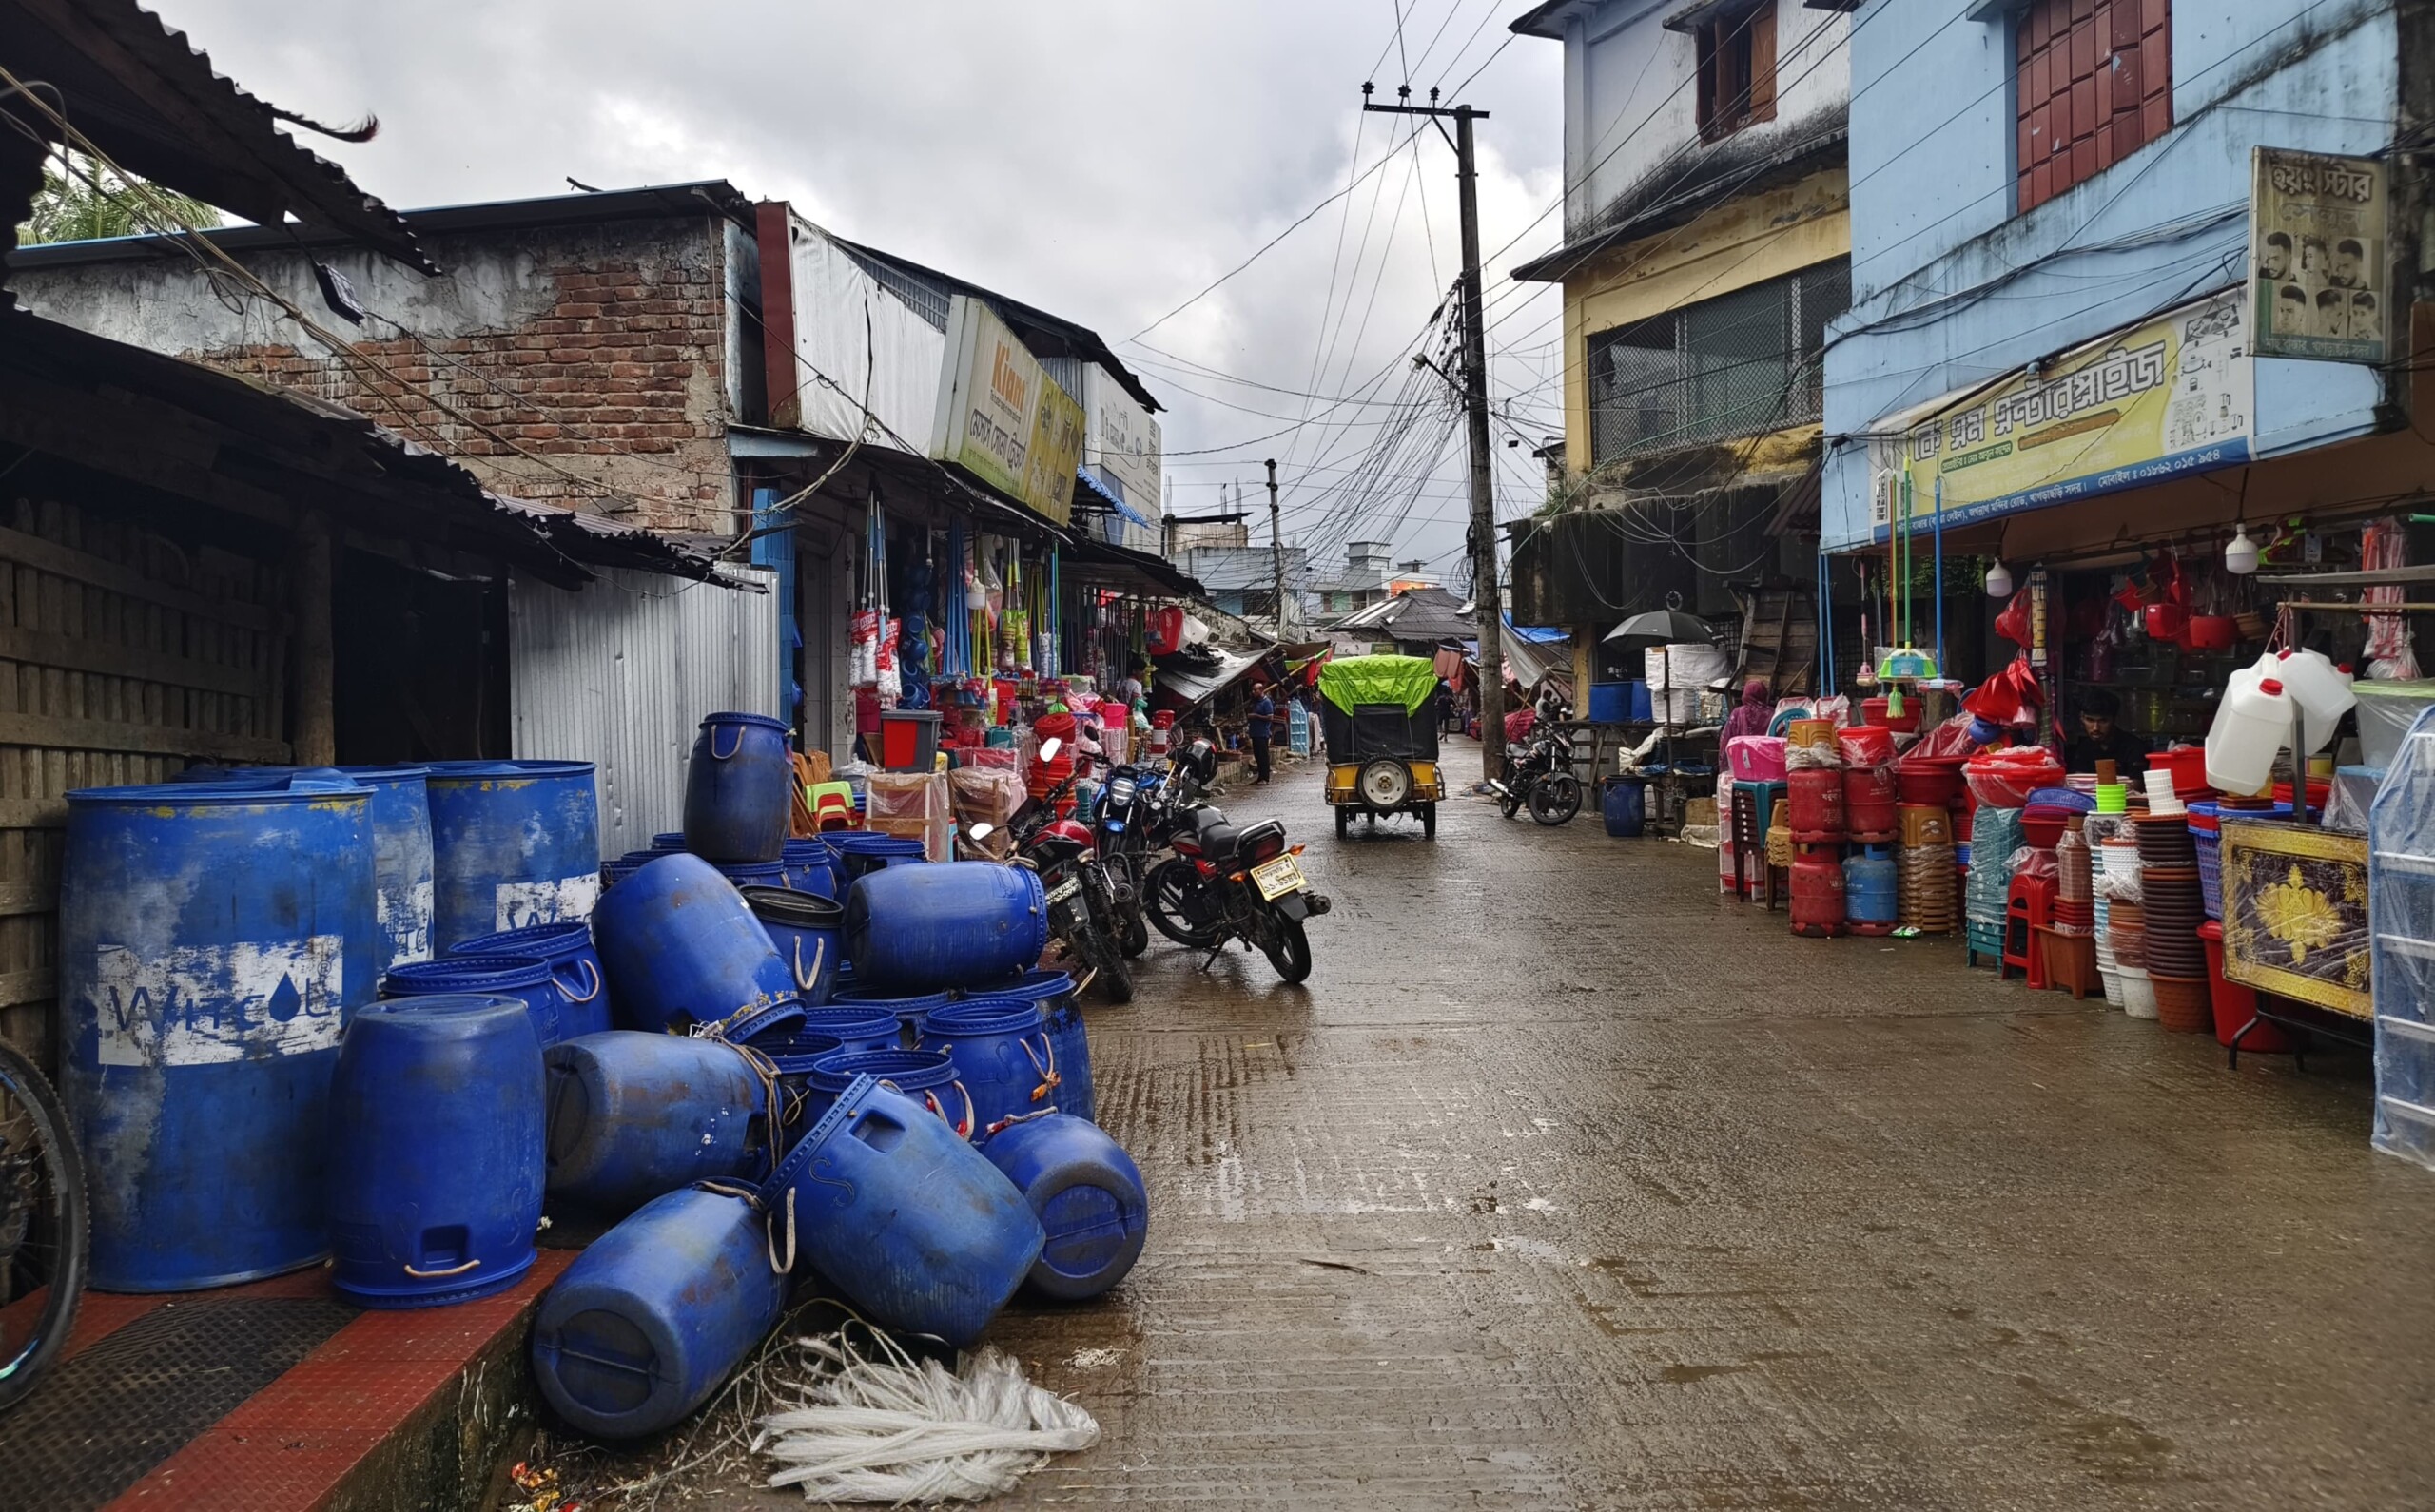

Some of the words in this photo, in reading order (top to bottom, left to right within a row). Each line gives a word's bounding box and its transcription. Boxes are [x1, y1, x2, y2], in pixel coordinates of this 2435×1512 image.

[2323, 165, 2372, 202] স্টার
[991, 339, 1026, 413] Kiam
[1950, 407, 1986, 451] এম
[1994, 339, 2166, 438] এন্টারপ্রাইজ
[2029, 484, 2064, 503] খাগড়াছড়ি
[2098, 470, 2131, 488] মোবাইল
[2139, 461, 2172, 478] ০১৮৬২
[2174, 456, 2195, 469] ০১৫
[2198, 449, 2221, 464] ৯৫৪
